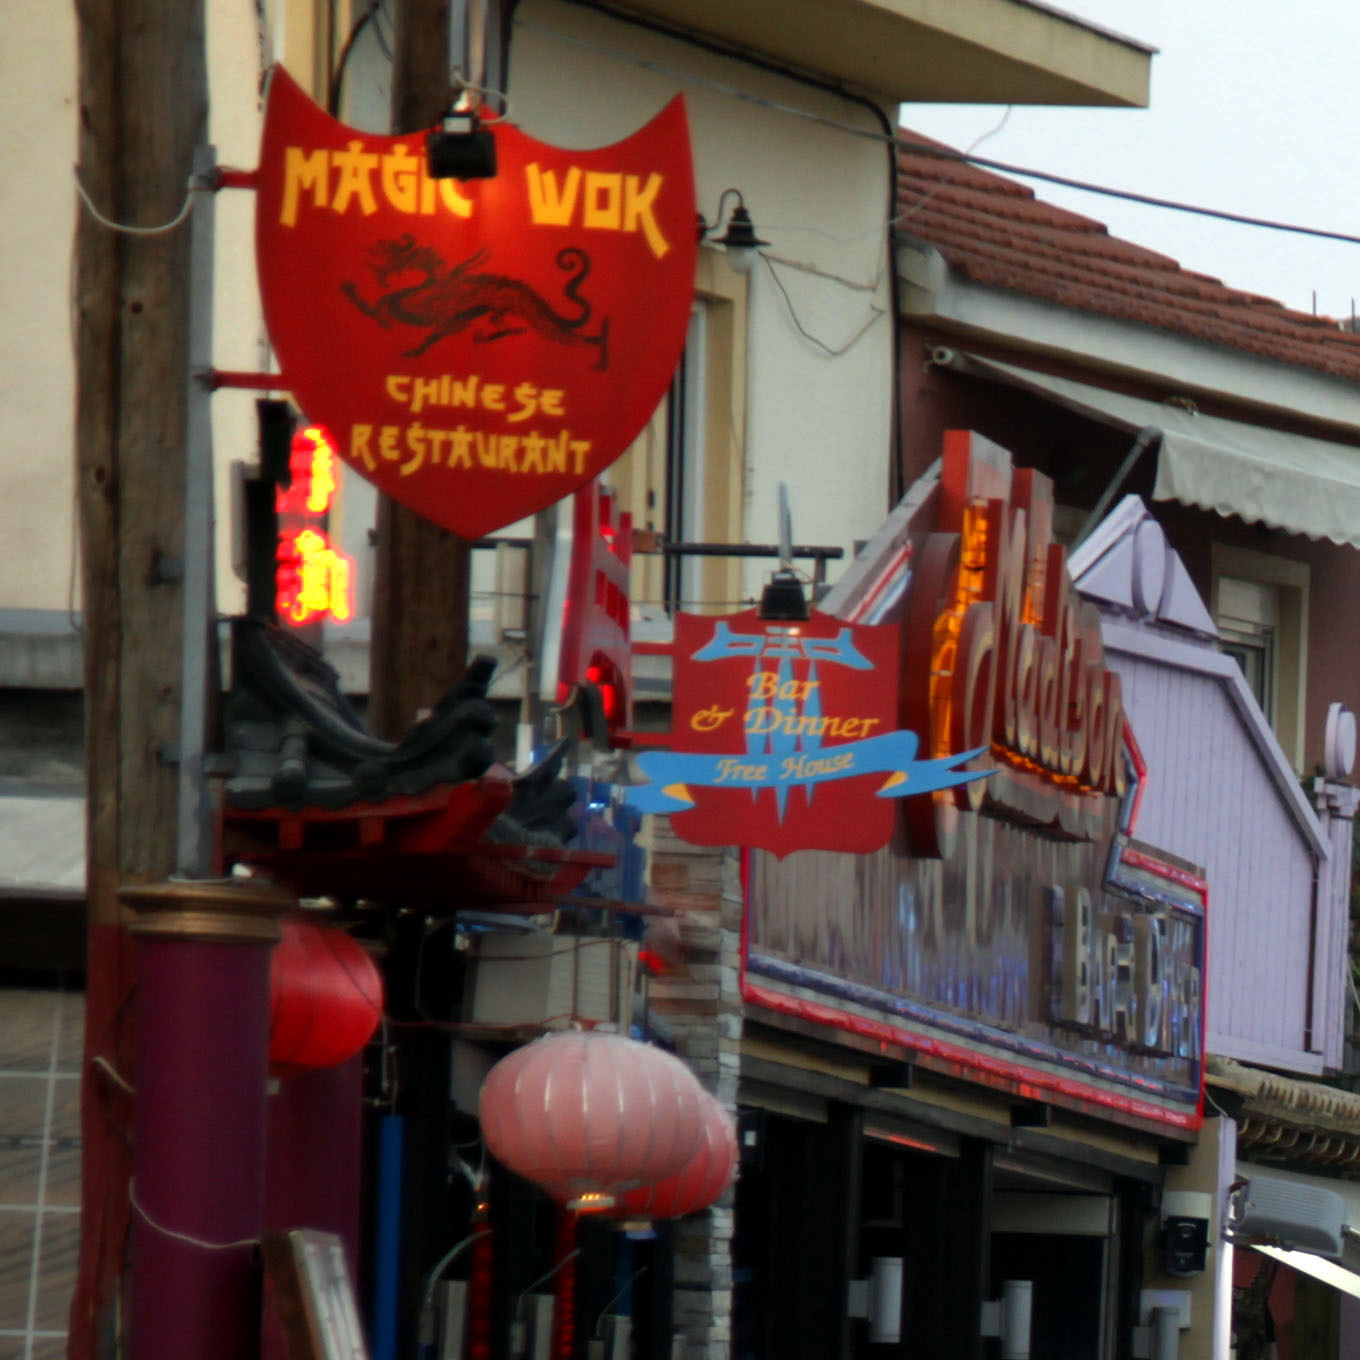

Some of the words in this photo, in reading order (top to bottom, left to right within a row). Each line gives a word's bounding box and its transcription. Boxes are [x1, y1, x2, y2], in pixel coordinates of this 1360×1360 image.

[280, 140, 473, 230] MAGIC
[525, 162, 670, 260] WOK
[386, 374, 565, 423] CHINESE
[350, 423, 592, 477] RESTAURANT
[746, 671, 820, 701] Bar
[690, 708, 734, 733] &
[743, 708, 880, 740] Dinner
[715, 757, 768, 784] Free
[780, 750, 855, 782] House
